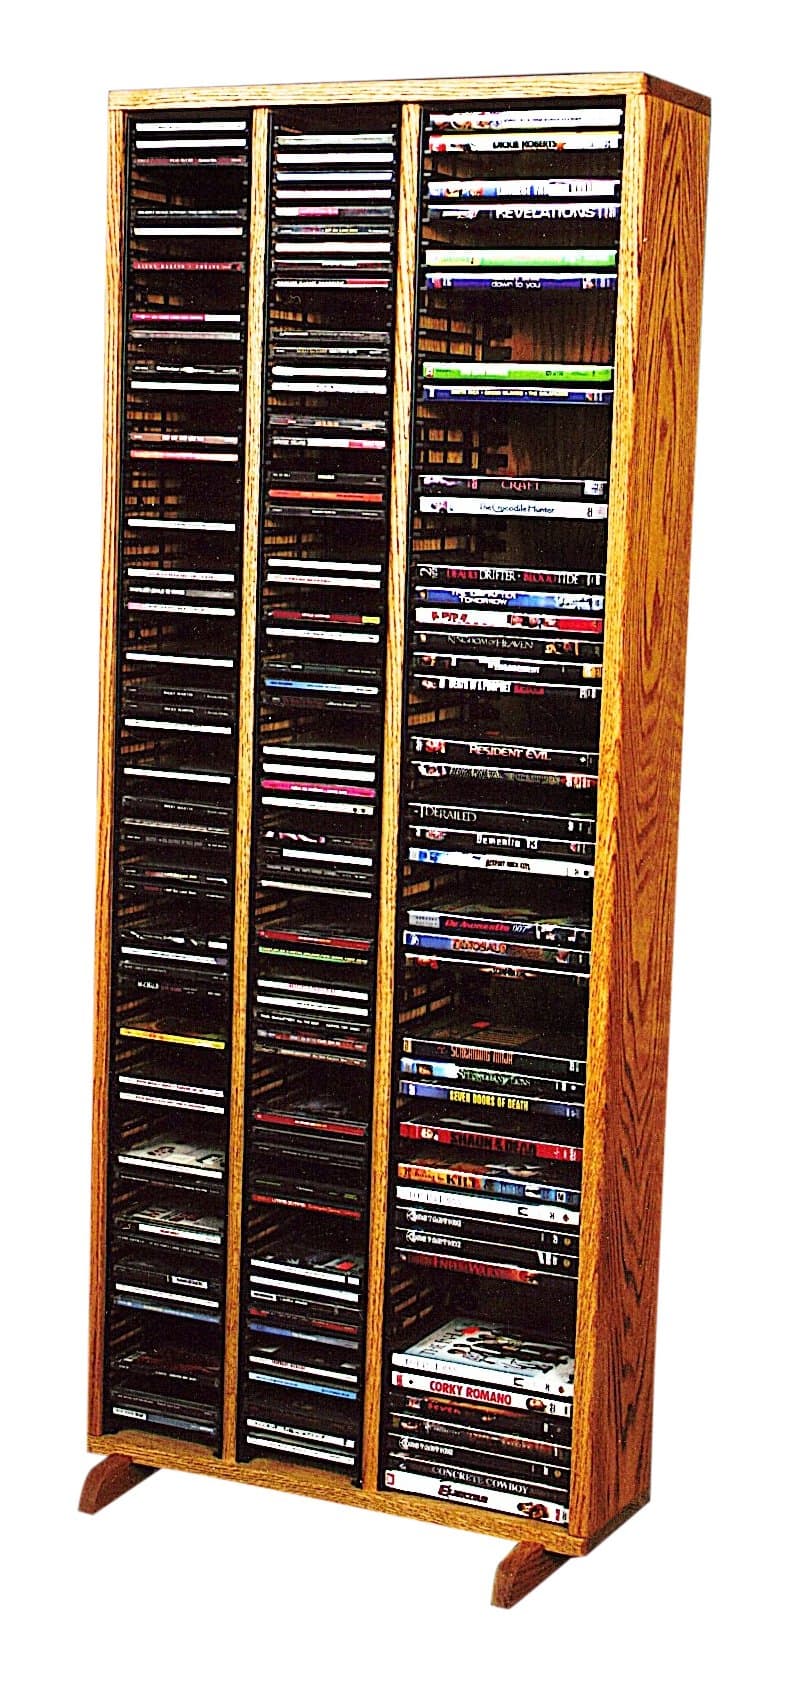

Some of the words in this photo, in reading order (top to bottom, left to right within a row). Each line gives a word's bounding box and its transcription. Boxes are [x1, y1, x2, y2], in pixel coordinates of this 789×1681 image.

[496, 209, 595, 219] REVELATIONS
[480, 568, 516, 581] DRIFTER
[496, 639, 534, 649] HEAVEN
[469, 744, 524, 757] RESIDENT
[525, 750, 551, 761] EVIL
[425, 806, 477, 822] DERAILED
[429, 1380, 463, 1396] CORKY
[466, 1386, 512, 1405] ROMANO
[432, 1466, 484, 1485] CONCRETE
[486, 1478, 529, 1495] COWBOY
